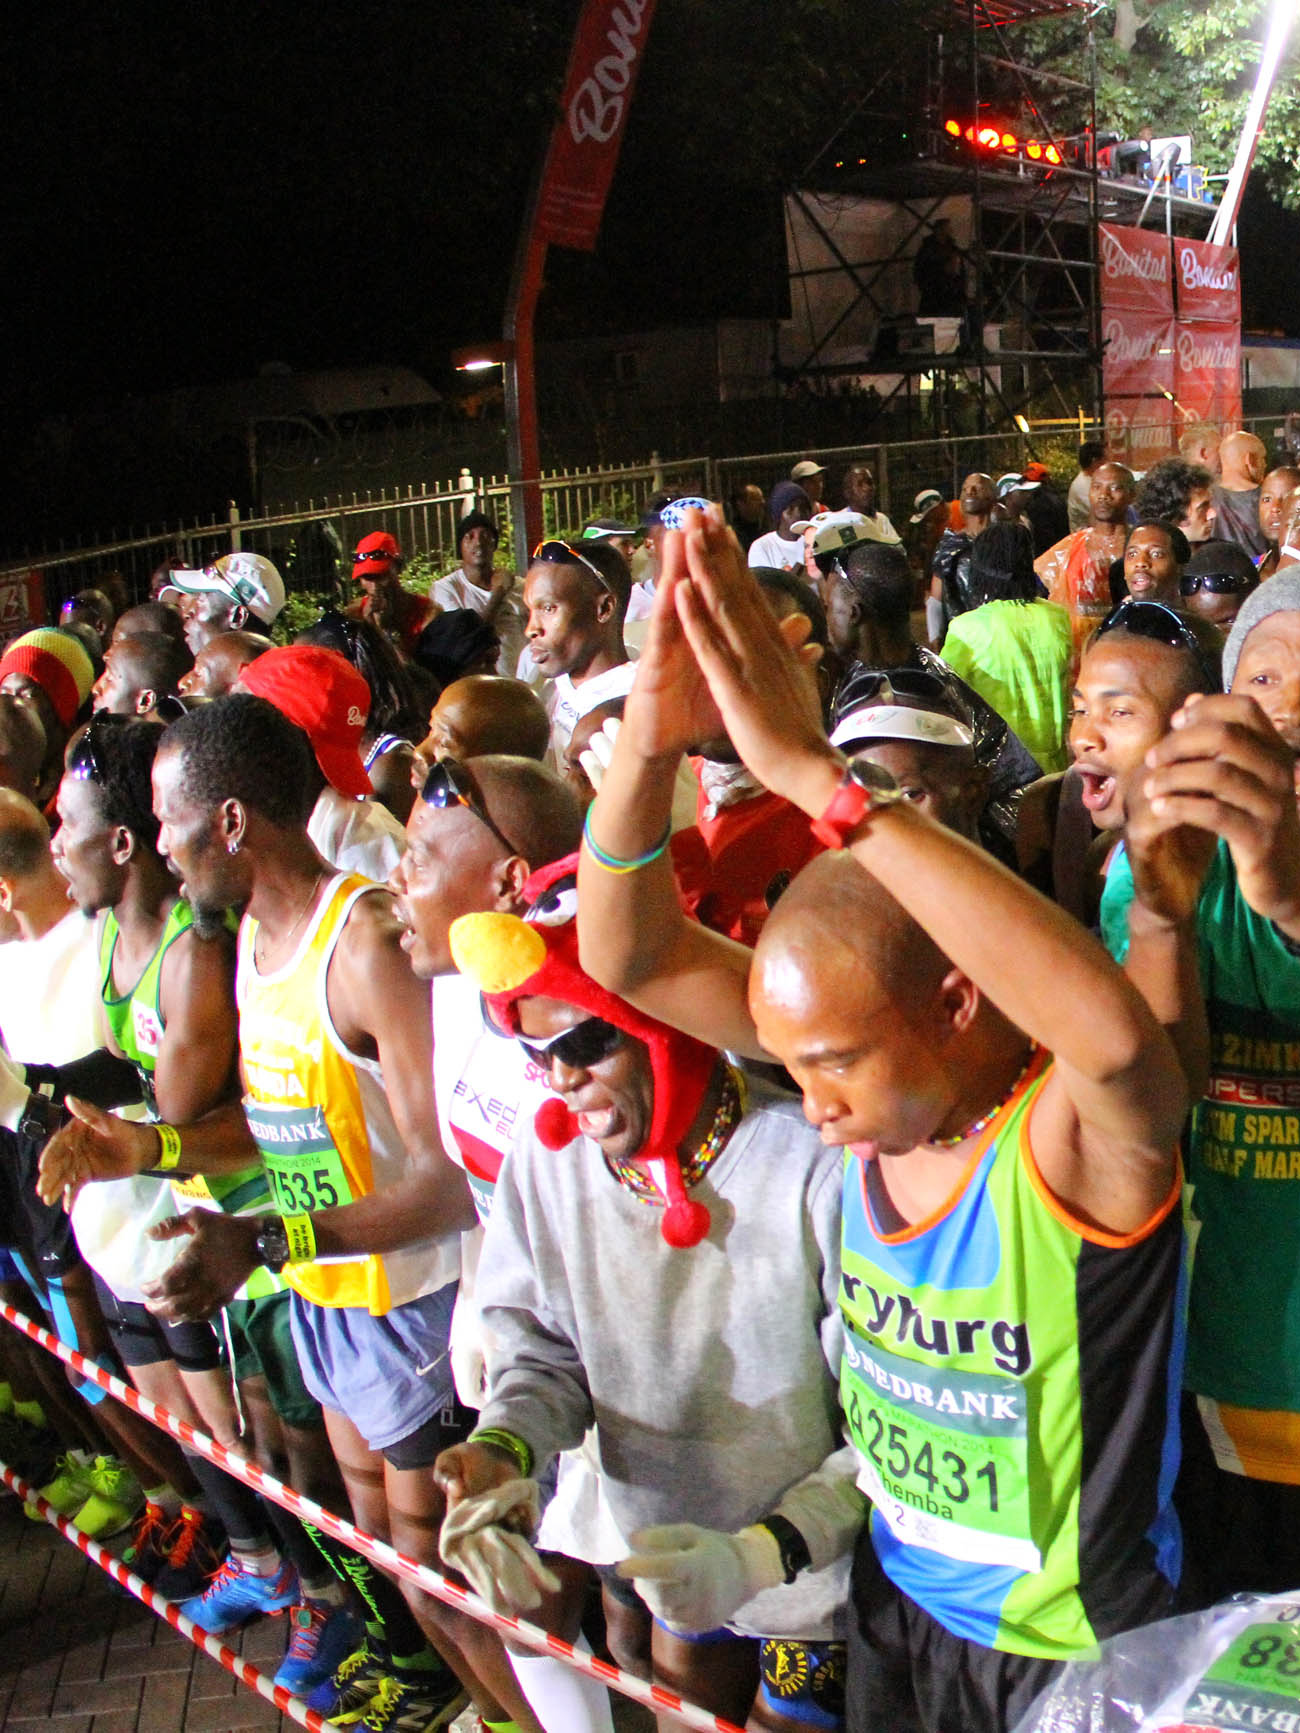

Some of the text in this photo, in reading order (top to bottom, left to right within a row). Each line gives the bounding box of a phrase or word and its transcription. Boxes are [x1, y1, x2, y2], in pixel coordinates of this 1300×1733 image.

[1102, 235, 1168, 283] Bonitas
[1178, 330, 1238, 372] Bonitas
[1243, 1114, 1300, 1144] SPAR
[859, 1350, 1020, 1420] NEDBANK
